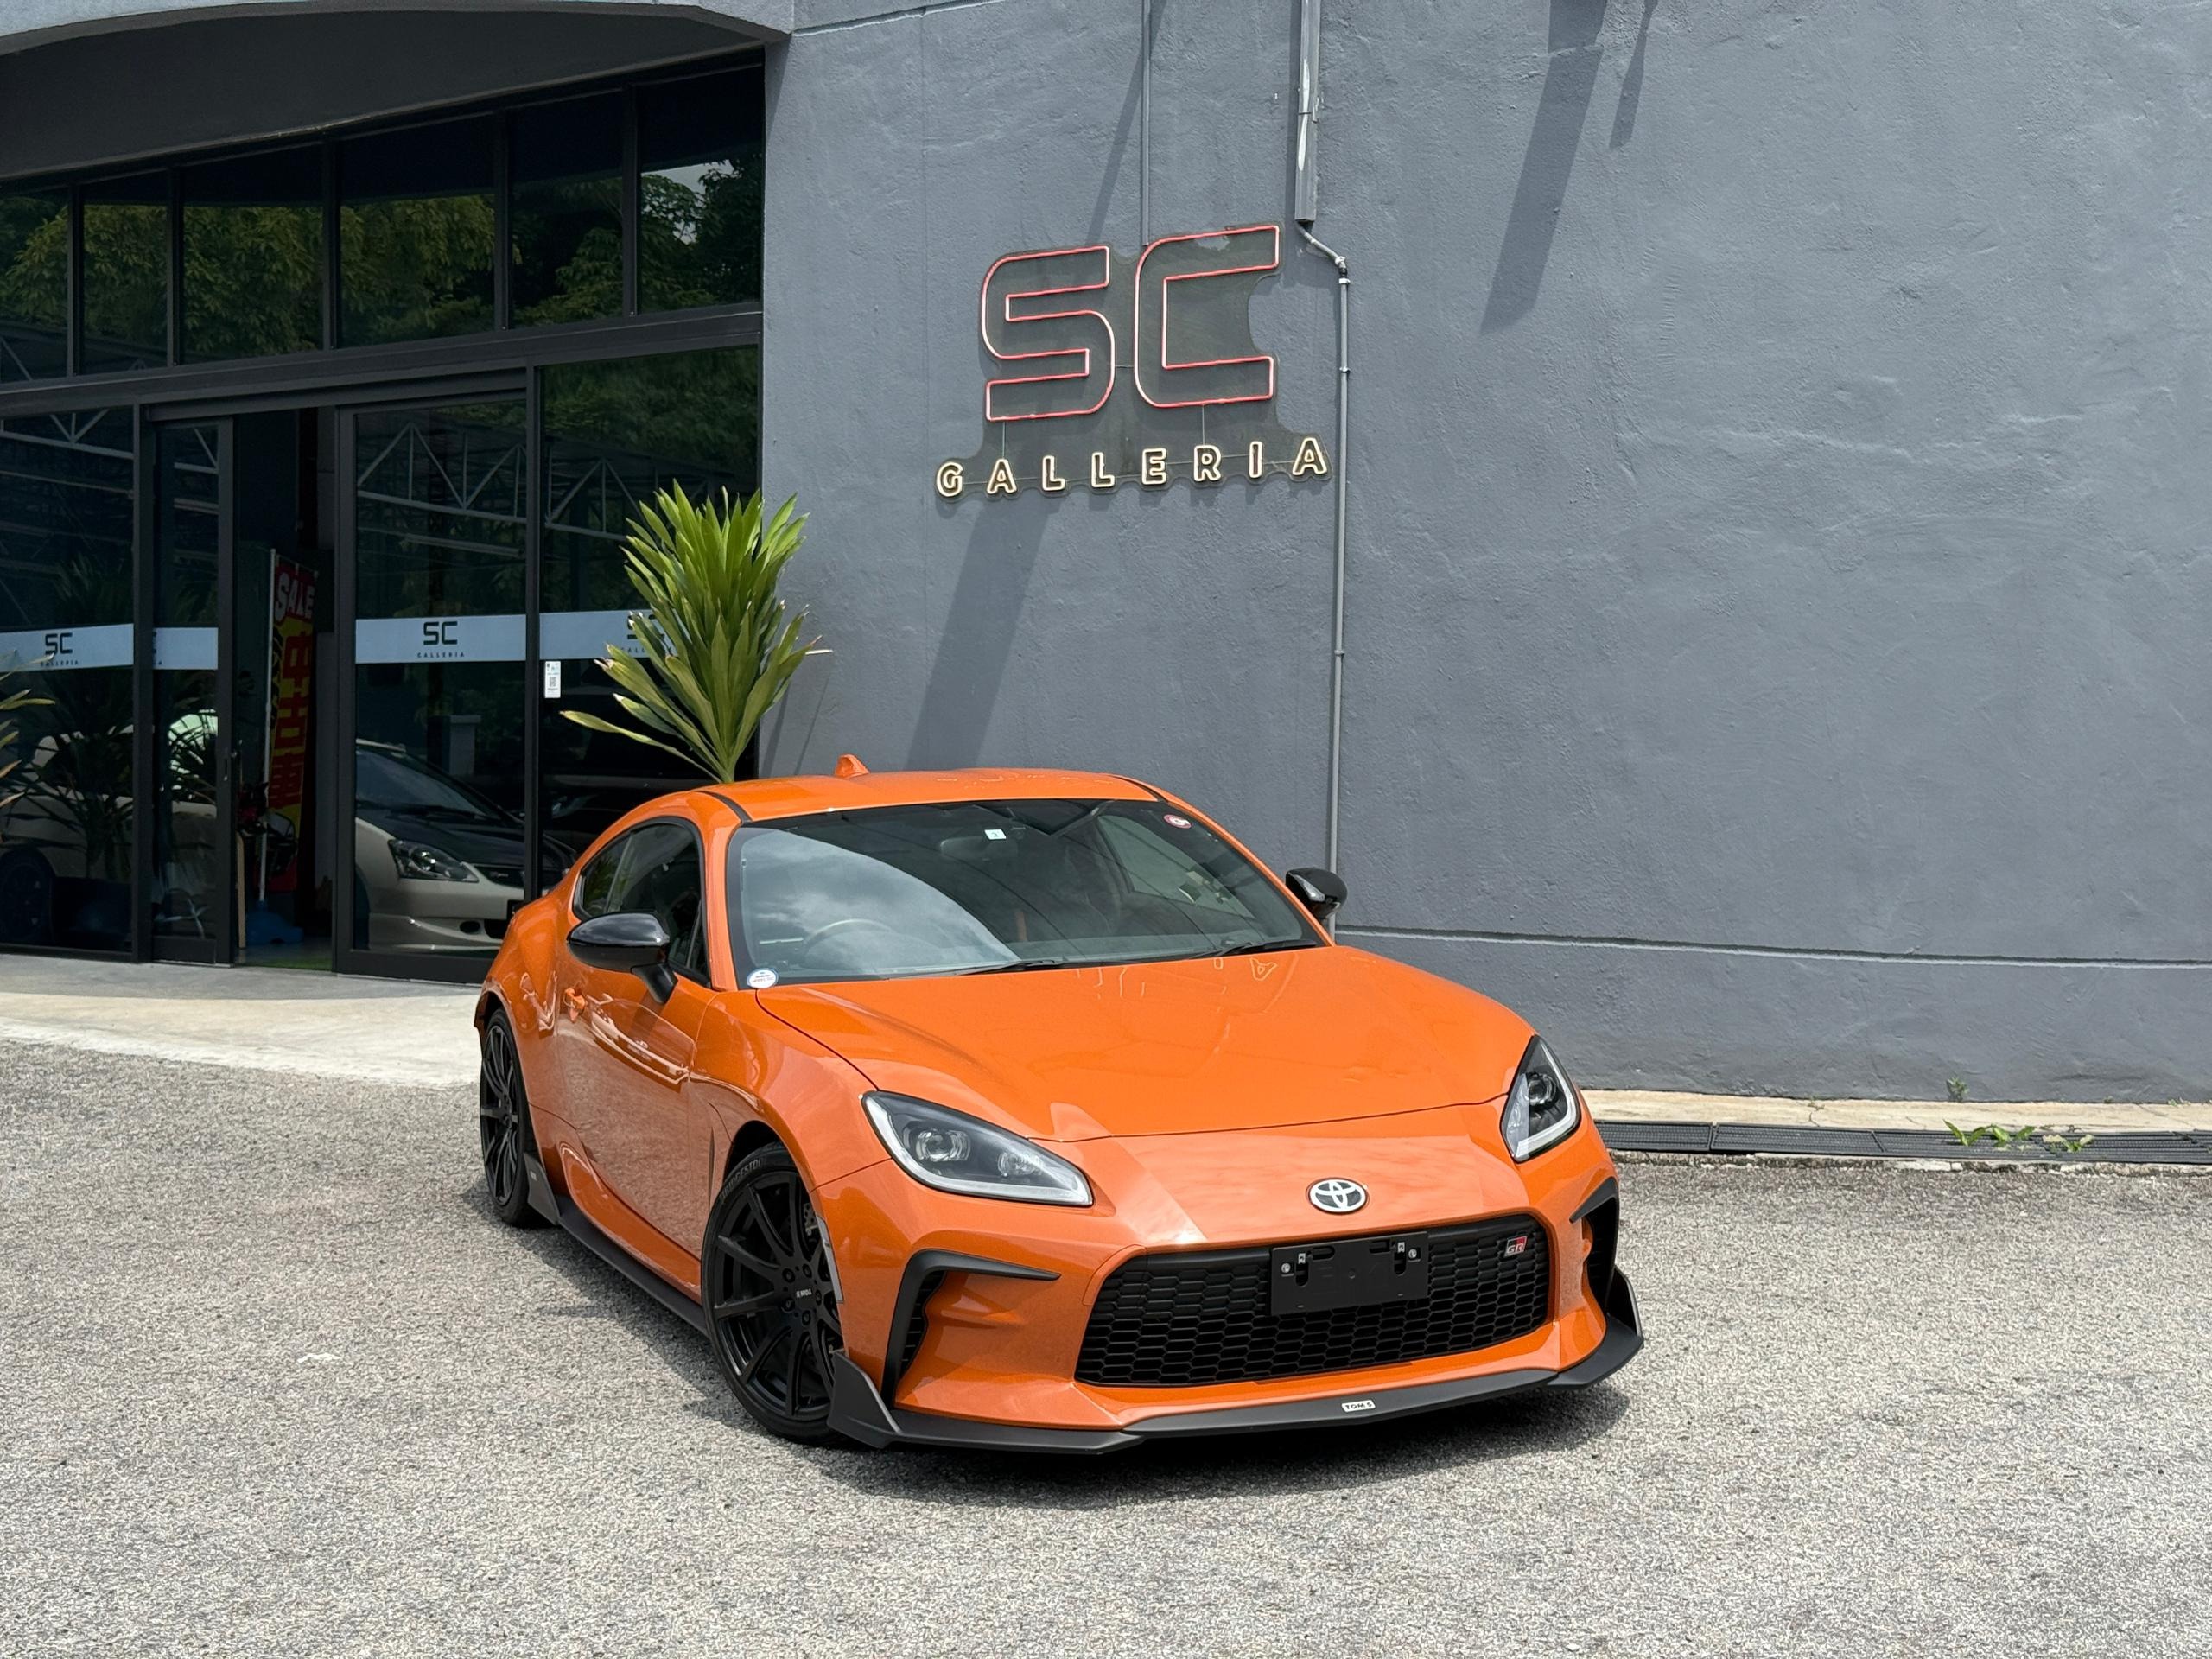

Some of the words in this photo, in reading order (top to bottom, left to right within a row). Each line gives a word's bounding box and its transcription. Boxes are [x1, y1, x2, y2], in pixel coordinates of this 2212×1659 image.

[981, 225, 1281, 422] SC
[936, 437, 1327, 497] GALLERIA
[275, 572, 315, 621] SALE
[45, 632, 73, 655] SC
[423, 620, 457, 645] SC
[1506, 1243, 1524, 1254] GR
